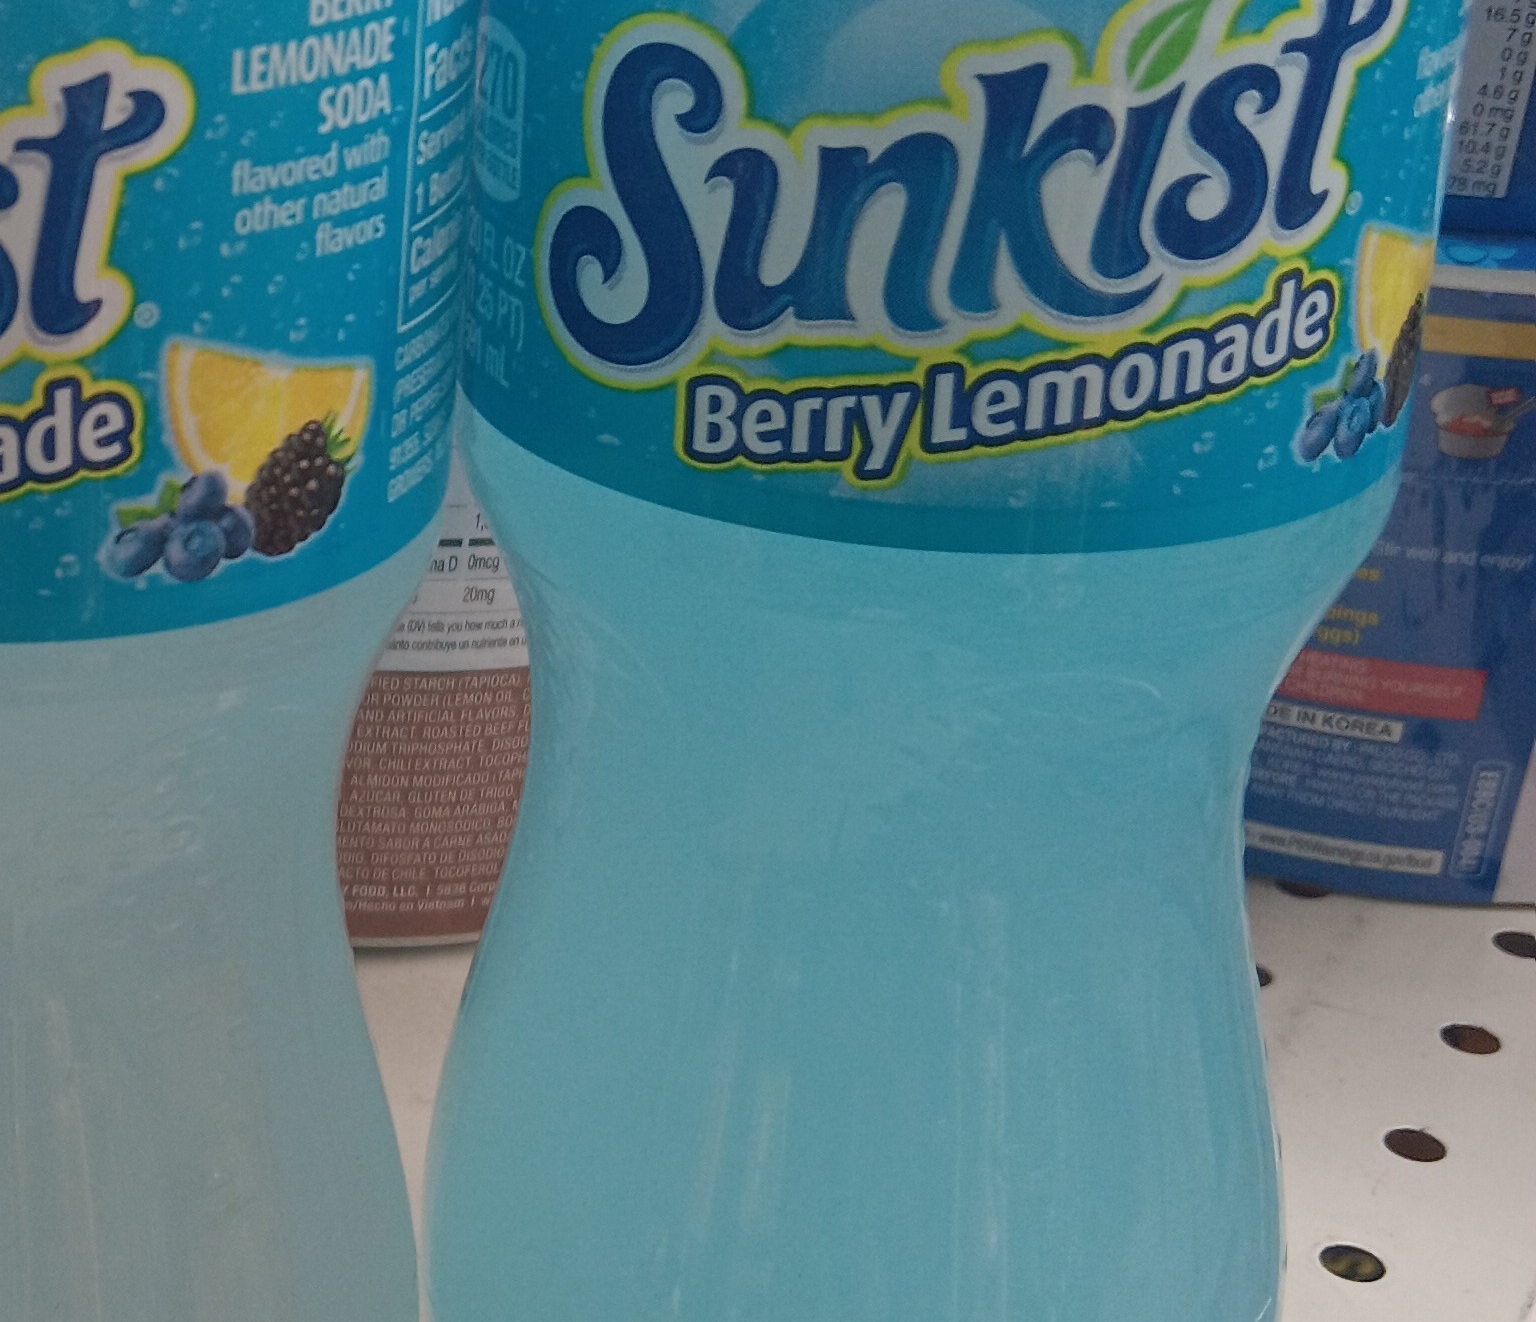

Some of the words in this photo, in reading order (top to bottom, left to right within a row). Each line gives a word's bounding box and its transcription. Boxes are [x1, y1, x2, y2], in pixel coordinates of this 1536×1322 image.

[230, 15, 398, 96] LEMONADE
[317, 71, 392, 135] SODA
[230, 138, 339, 197] flavored
[342, 127, 391, 173] with
[234, 194, 305, 237] other
[312, 165, 389, 221] natural
[315, 212, 386, 259] flavors
[691, 384, 911, 469] Berry
[928, 281, 1331, 445] Lemonade
[467, 553, 501, 574] 0mcg
[462, 586, 496, 606] 20mg
[403, 676, 456, 691] STARCH
[382, 692, 440, 707] POWDER
[386, 708, 457, 723] ARTIFICIAL
[1320, 713, 1394, 739] KOREA
[421, 724, 482, 740] ROASTED
[483, 722, 516, 736] BEEF
